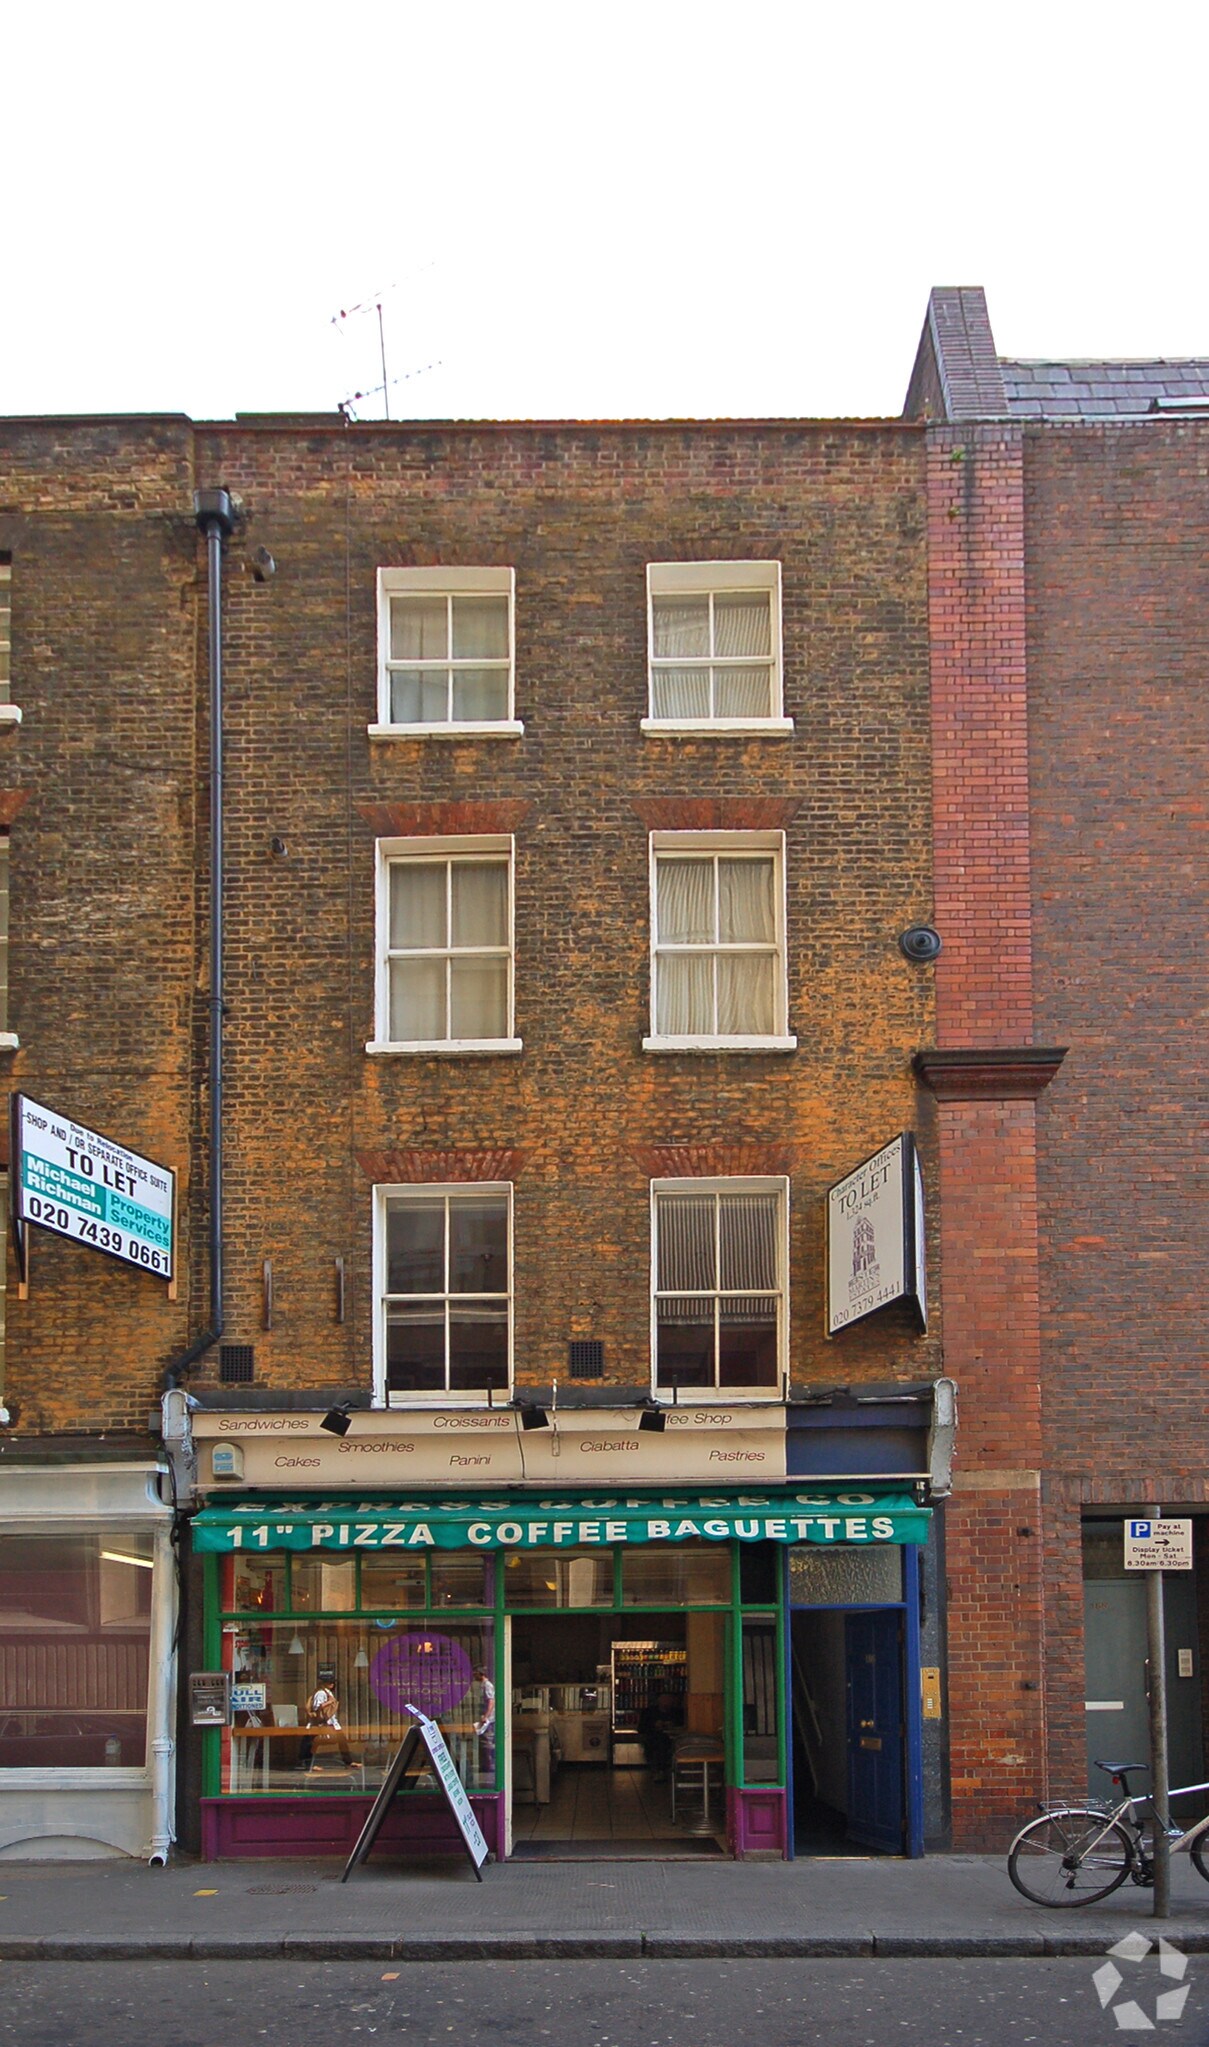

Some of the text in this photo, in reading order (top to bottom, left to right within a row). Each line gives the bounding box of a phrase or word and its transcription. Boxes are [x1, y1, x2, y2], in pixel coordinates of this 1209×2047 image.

[27, 1112, 48, 1131] SHOP
[51, 1125, 67, 1141] AND
[75, 1136, 86, 1151] OR
[87, 1143, 124, 1170] SEPARATE
[125, 1162, 148, 1182] OFFICE
[150, 1175, 167, 1193] SUITE
[70, 1124, 133, 1161] Due to Relocation
[27, 1155, 96, 1198] Michael
[65, 1146, 137, 1197] TO LET
[831, 1145, 901, 1202] Character Offices
[838, 1163, 891, 1214] TO LET
[27, 1171, 102, 1216] Richman
[110, 1194, 169, 1235] Property
[29, 1196, 169, 1273] 020 7439 0661
[110, 1208, 169, 1247] Services
[833, 1280, 900, 1327] 020 7379 4441
[218, 1418, 309, 1431] Sandwiches
[433, 1416, 511, 1429] Croissants
[693, 1412, 733, 1425] Shop
[274, 1449, 766, 1468] Cakes Panini Pastries
[338, 1440, 640, 1453] Smoothies Ciabatta
[226, 1517, 895, 1547] 11" PIZZA COFFEE BAGUETTES
[1135, 1522, 1149, 1537] P
